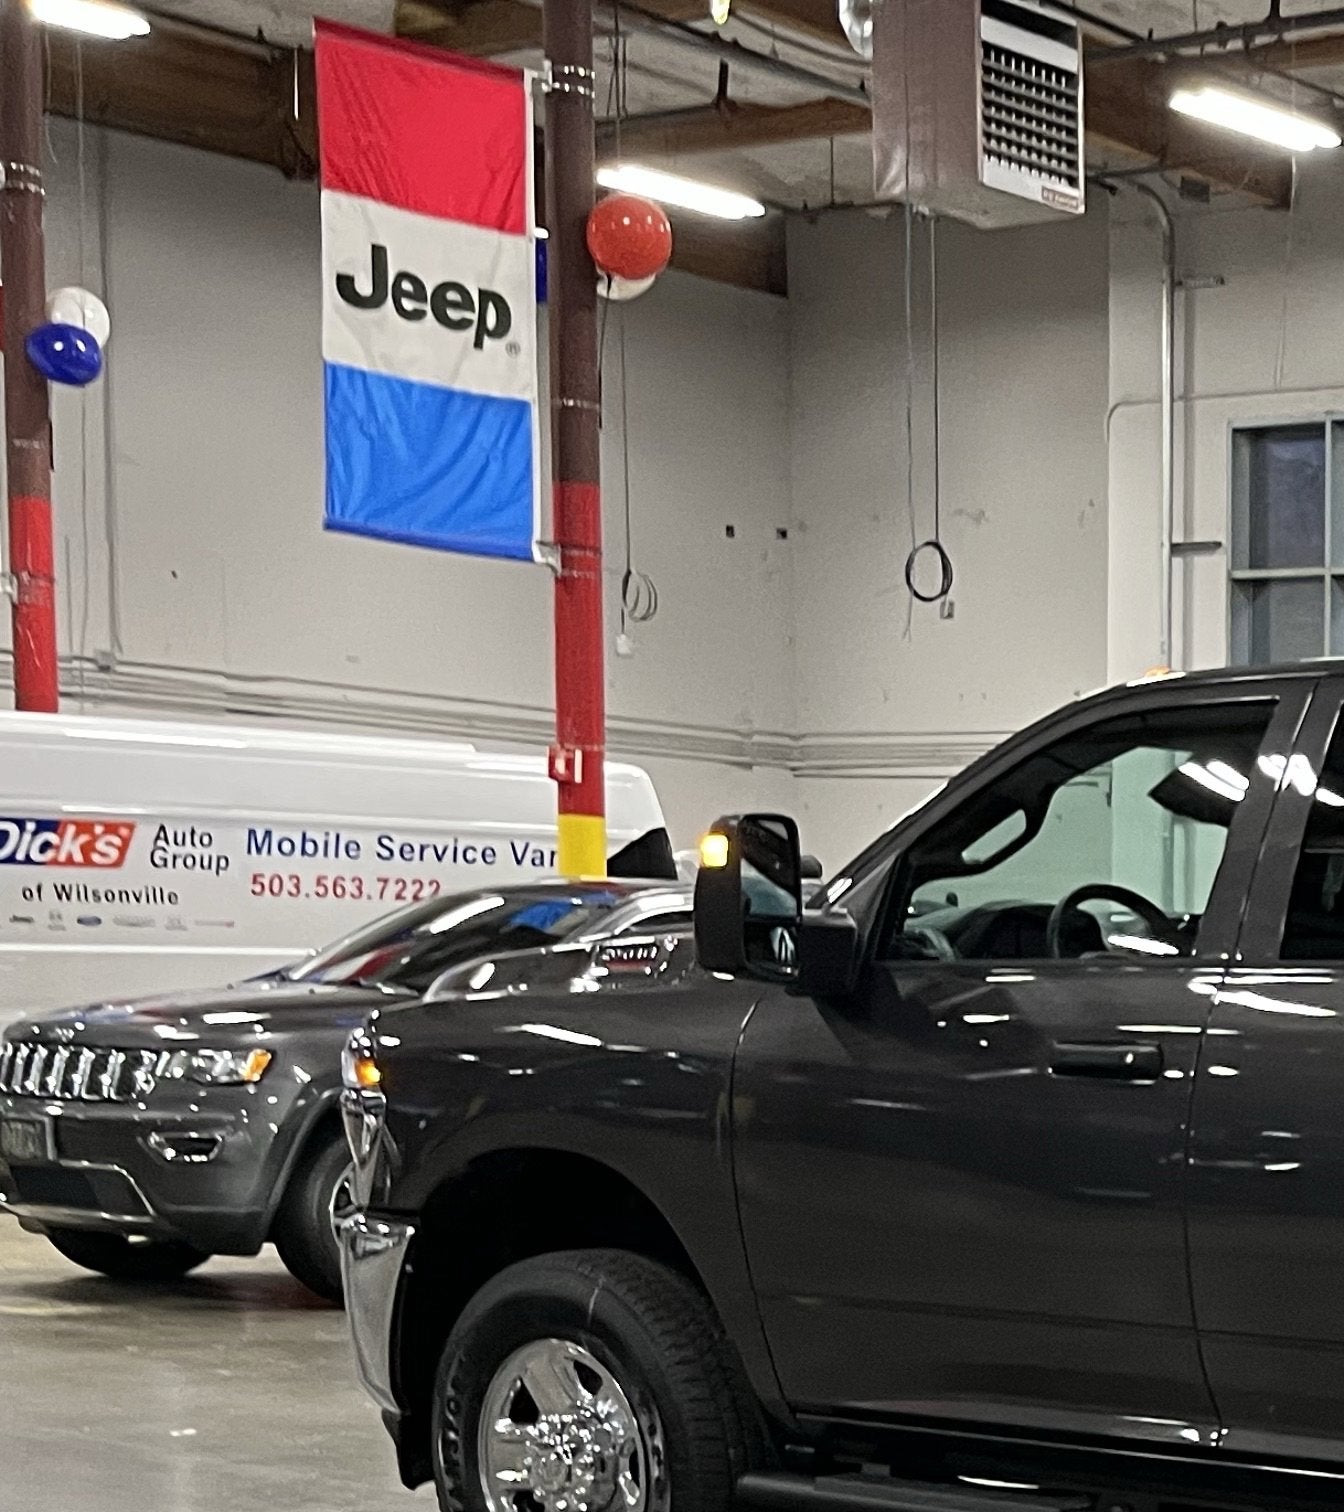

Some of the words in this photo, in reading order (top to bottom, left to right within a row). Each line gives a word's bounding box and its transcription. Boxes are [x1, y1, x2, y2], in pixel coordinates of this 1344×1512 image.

[335, 243, 512, 351] Jeep
[153, 824, 214, 849] Auto
[246, 828, 362, 861] Mobile
[375, 834, 497, 866] Service
[150, 847, 230, 877] Group
[22, 883, 43, 902] of
[53, 883, 180, 906] Wilsonville
[250, 872, 441, 903] 503.563.7222
